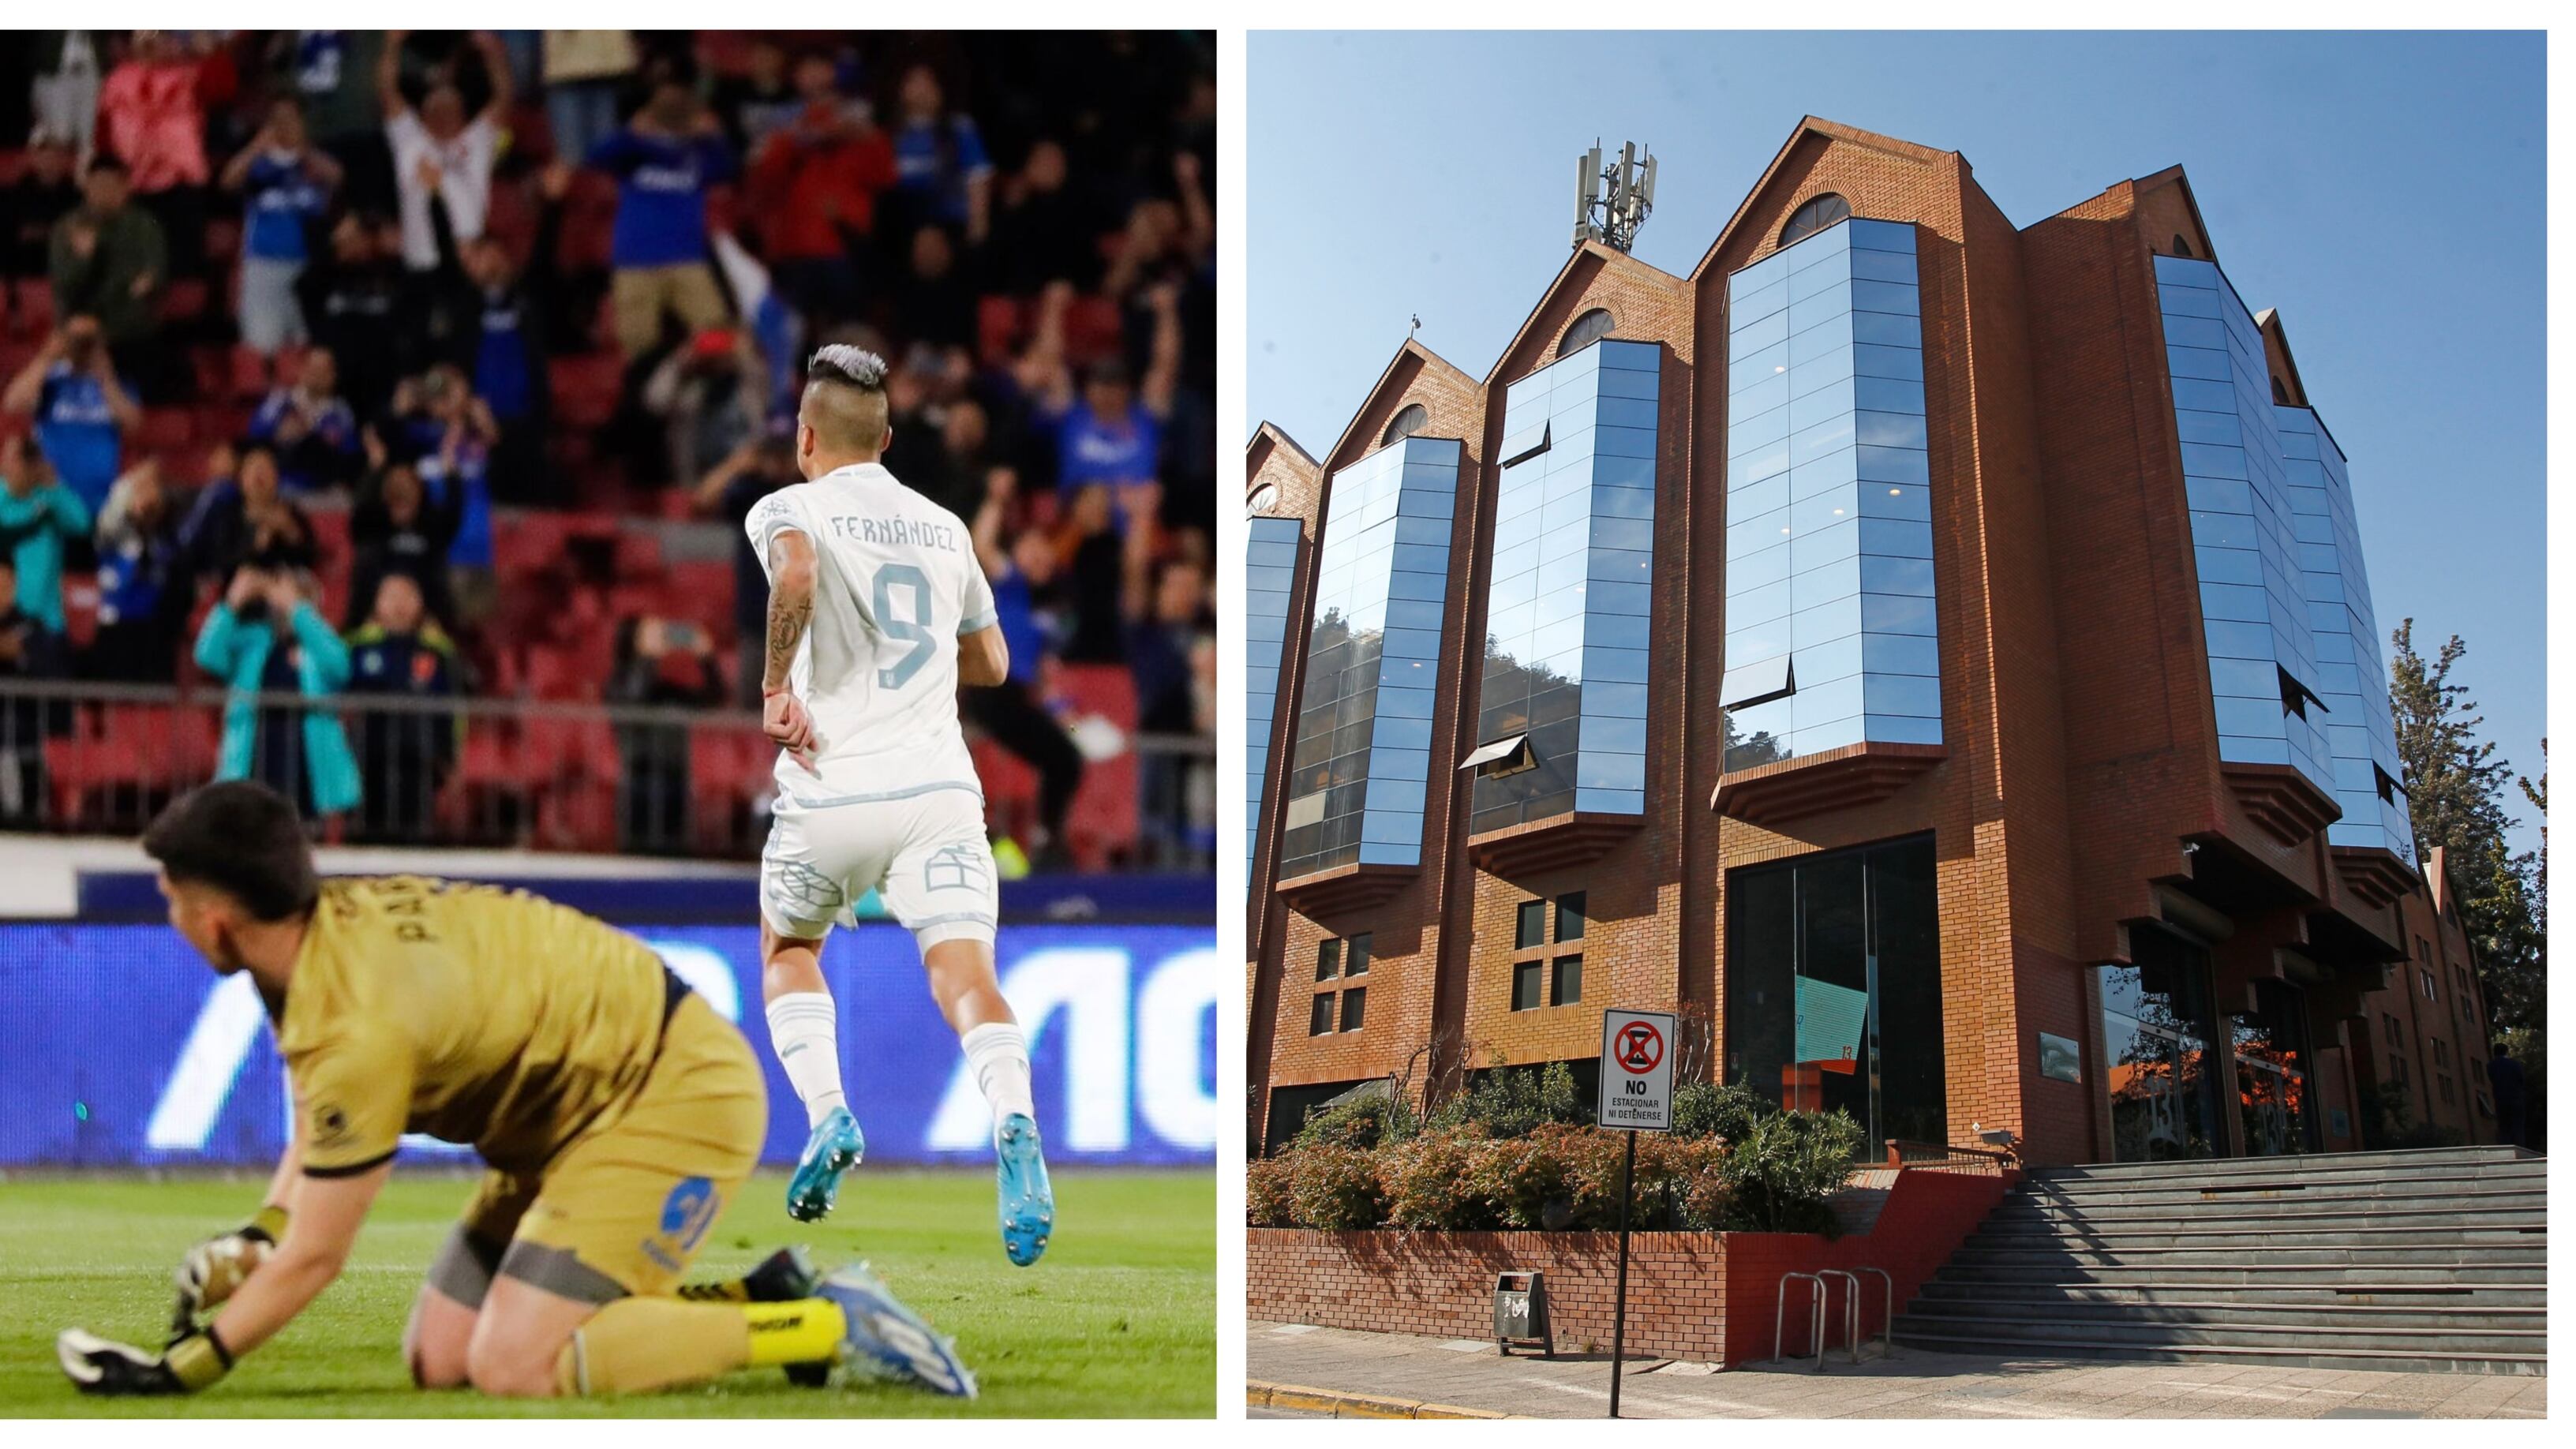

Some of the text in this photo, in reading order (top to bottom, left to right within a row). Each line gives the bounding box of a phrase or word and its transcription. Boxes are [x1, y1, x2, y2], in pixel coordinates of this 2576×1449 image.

[831, 514, 957, 552] FERNÁNDEZ
[872, 563, 938, 691] 9
[1842, 1046, 1852, 1061] 13
[1626, 1080, 1647, 1095] NO
[1612, 1097, 1659, 1109] ESTACIONAR
[1608, 1110, 1662, 1121] NI DETENERSE
